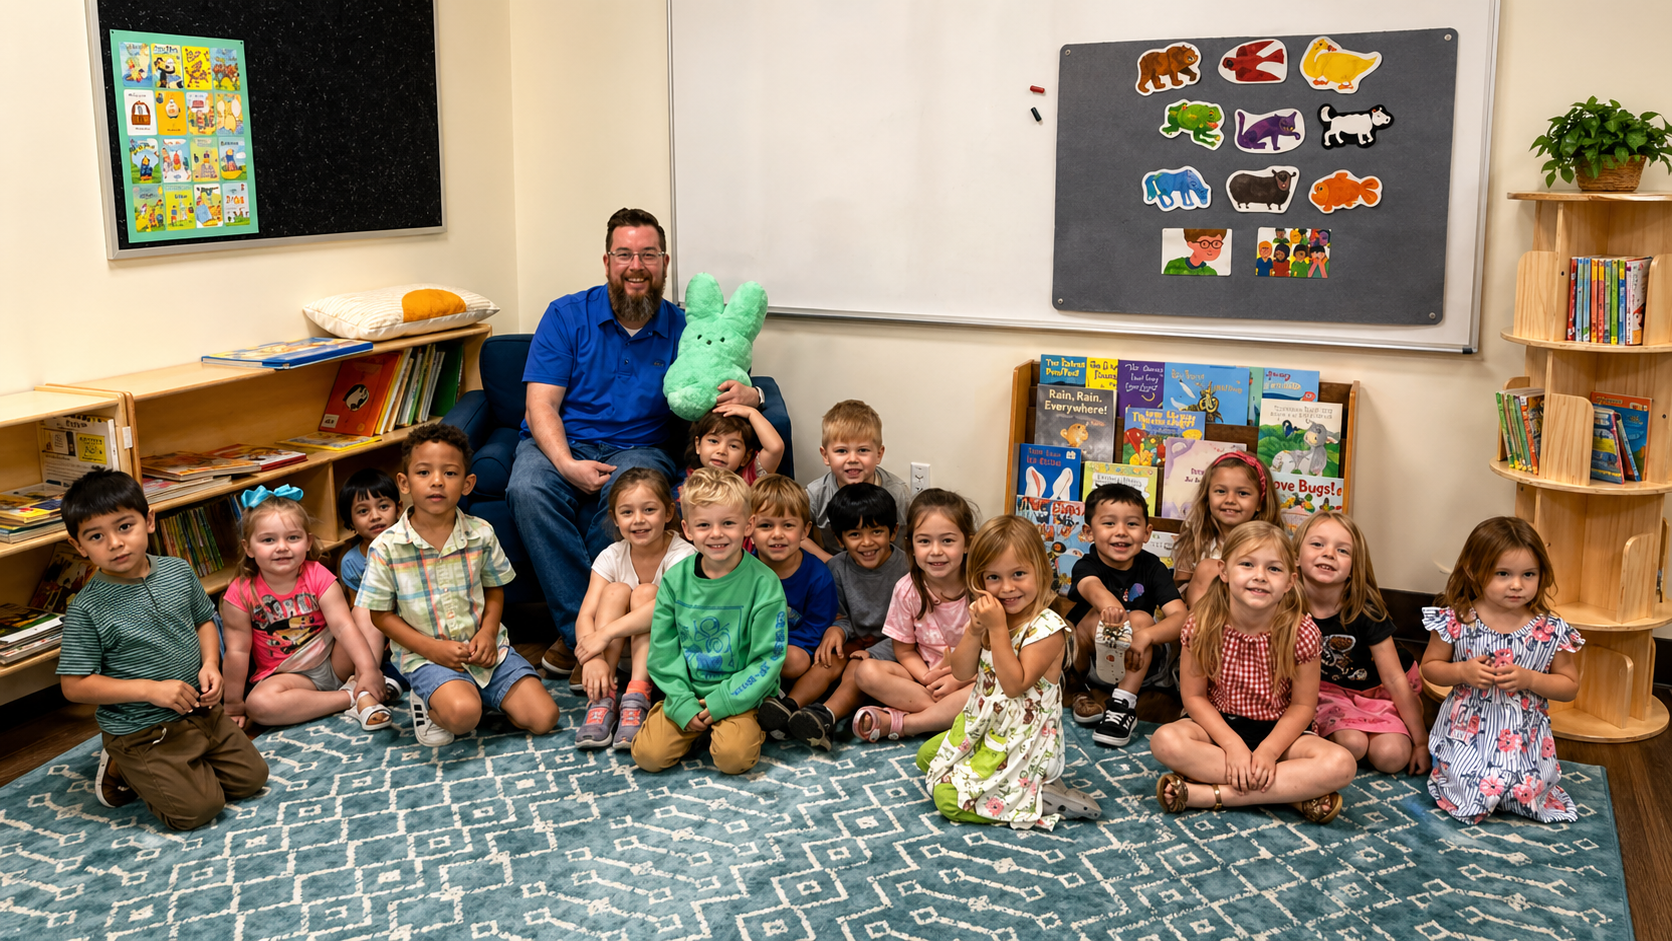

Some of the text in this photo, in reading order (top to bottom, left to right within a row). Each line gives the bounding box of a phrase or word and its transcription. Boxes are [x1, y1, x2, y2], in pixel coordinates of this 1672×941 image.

[1049, 388, 1075, 402] Rain,
[1044, 399, 1108, 415] Everywhere!
[1273, 478, 1336, 498] ove Bugs!
